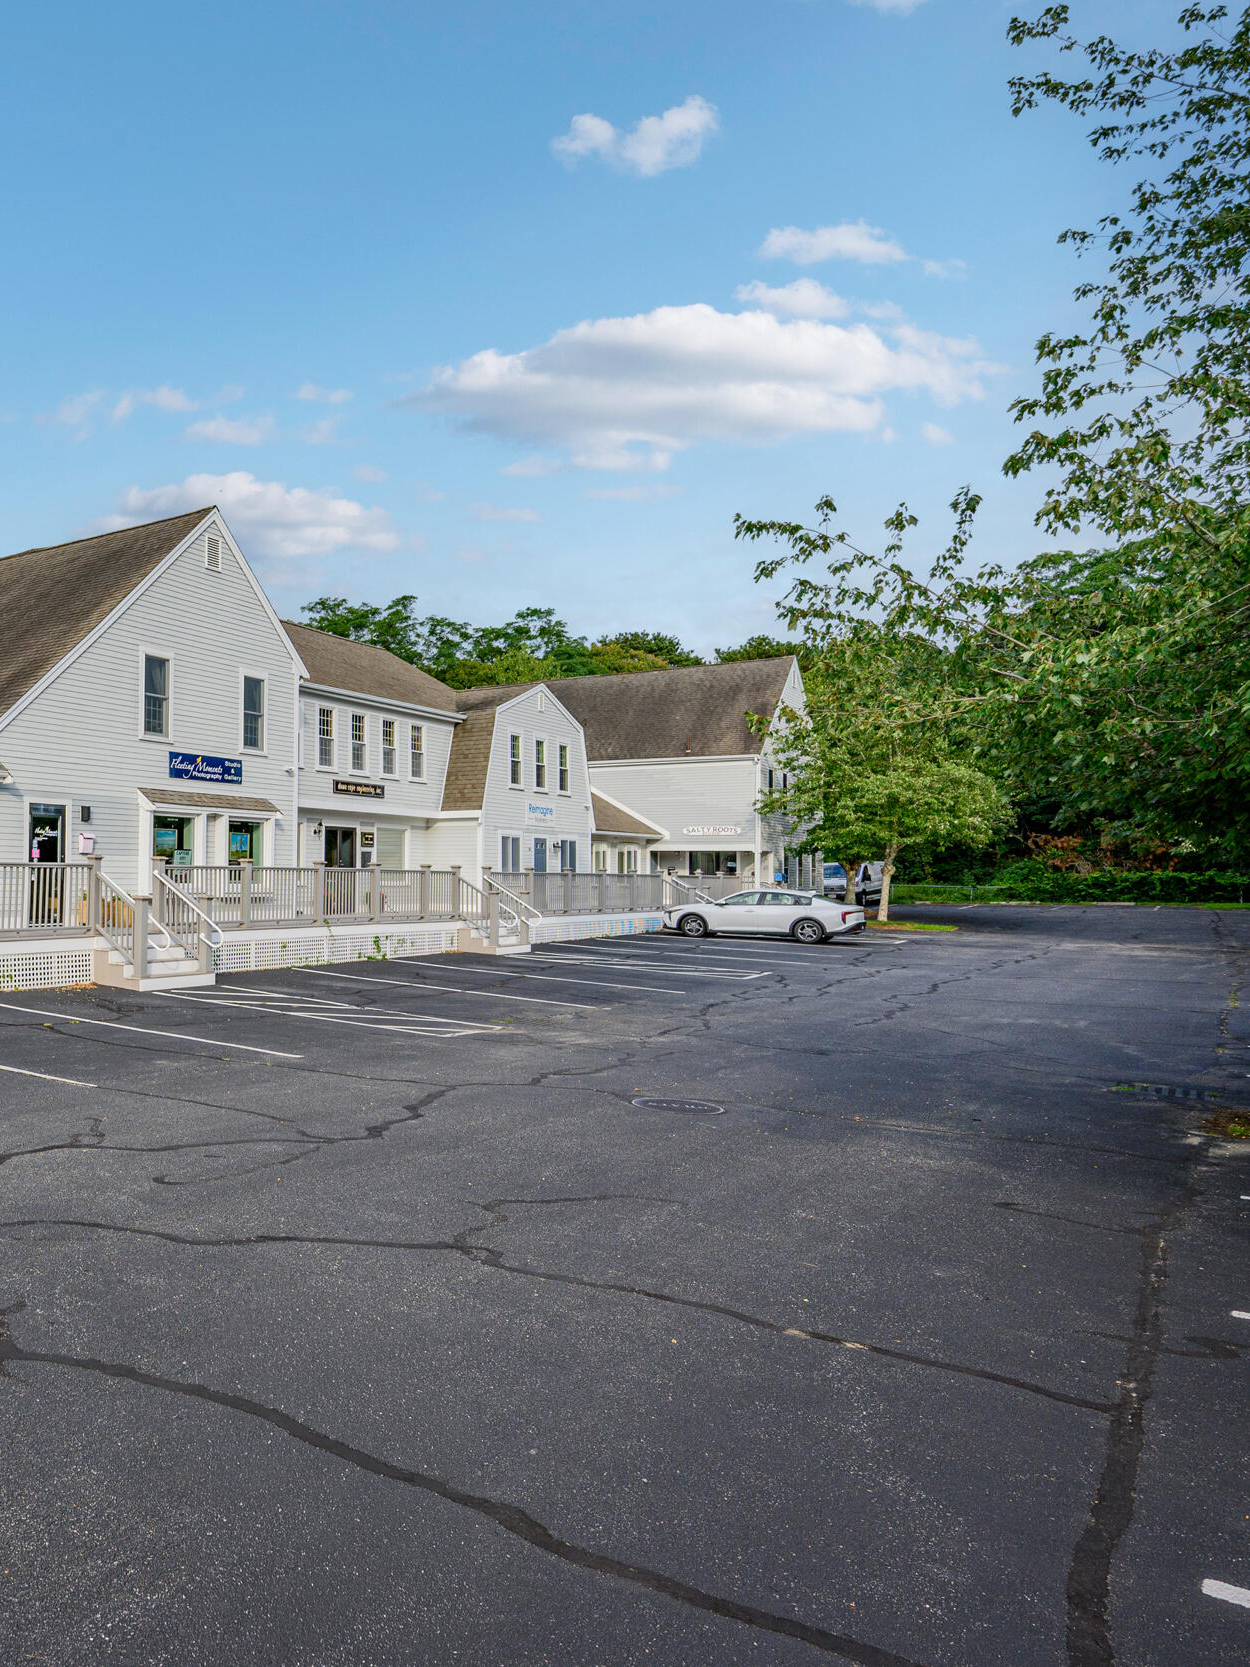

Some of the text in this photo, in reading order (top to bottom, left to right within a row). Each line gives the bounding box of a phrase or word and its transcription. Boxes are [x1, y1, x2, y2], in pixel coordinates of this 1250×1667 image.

[170, 756, 223, 779] Fleeting Moments
[225, 760, 241, 768] Studio
[192, 771, 242, 782] Photography Gallery
[712, 826, 738, 834] ROOTS
